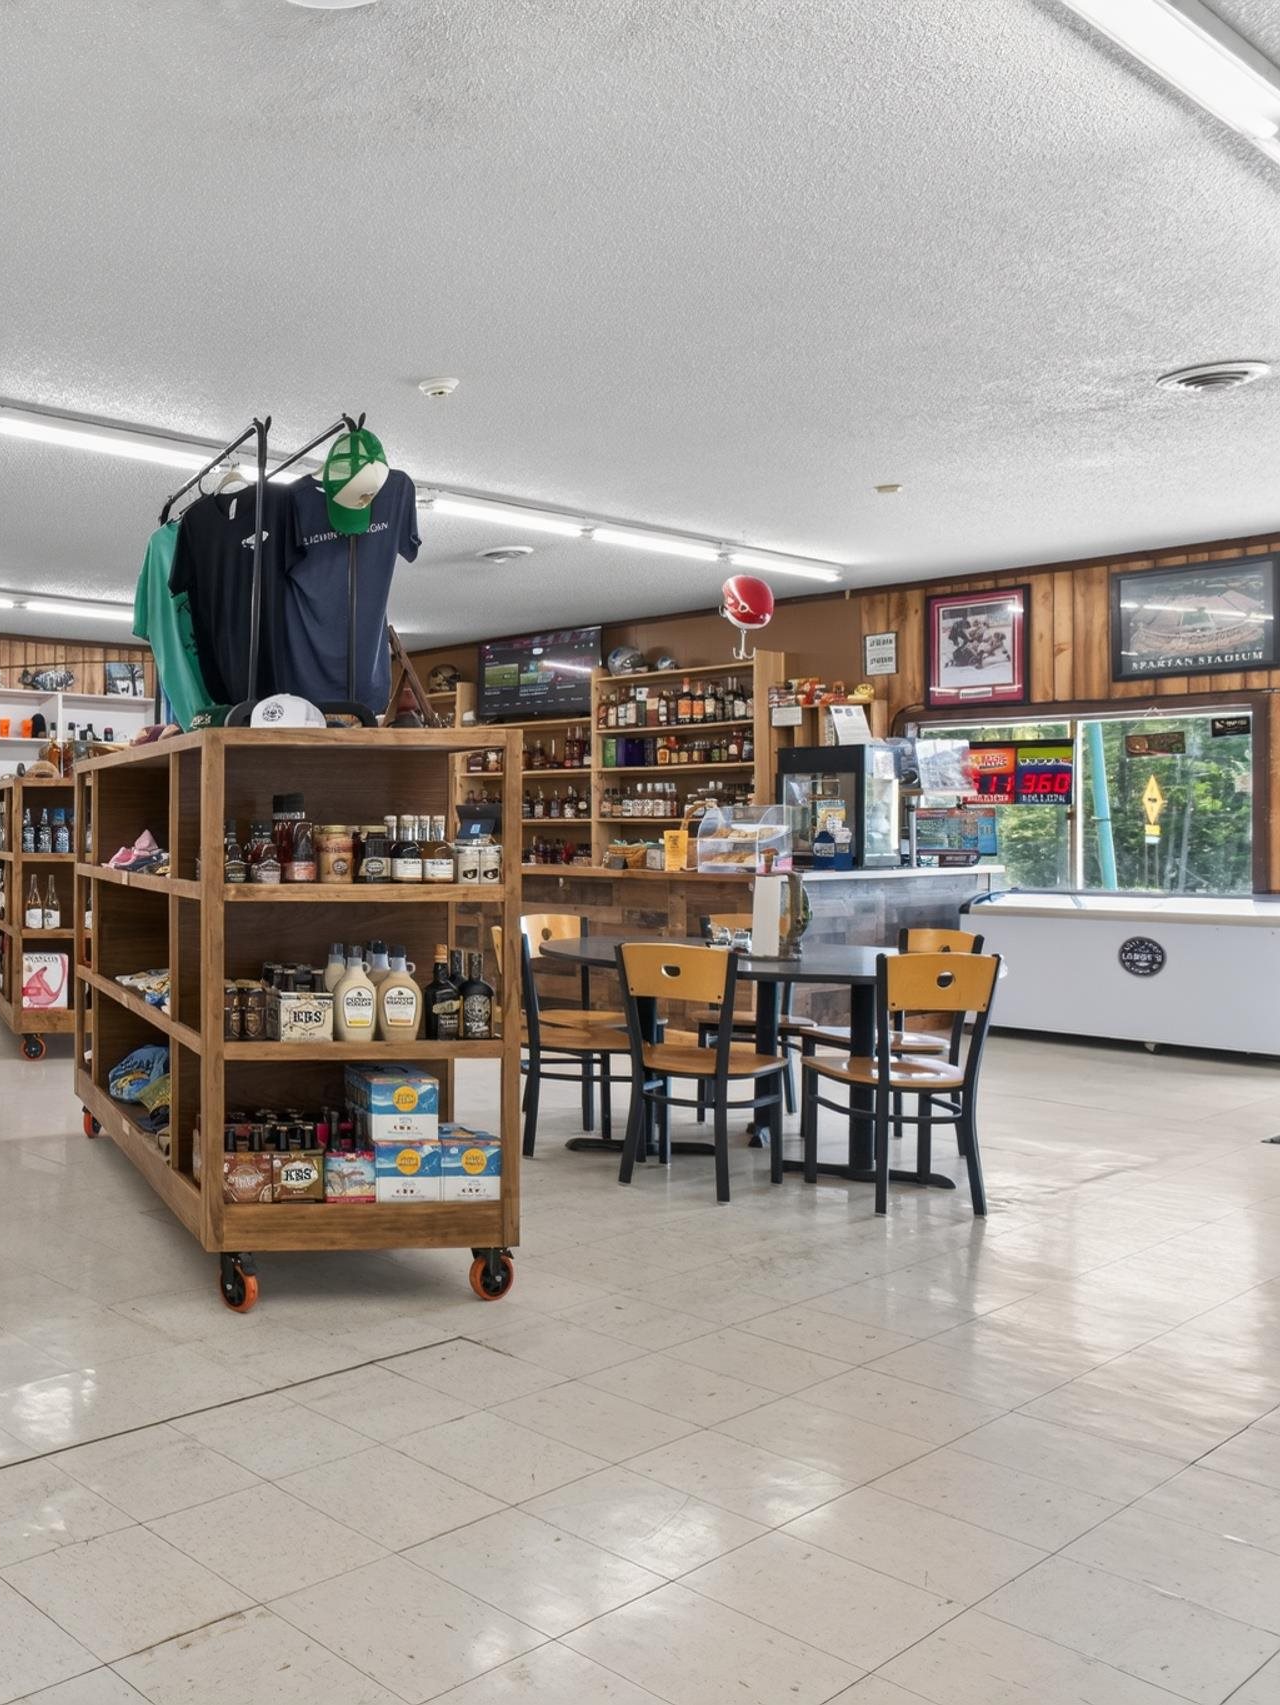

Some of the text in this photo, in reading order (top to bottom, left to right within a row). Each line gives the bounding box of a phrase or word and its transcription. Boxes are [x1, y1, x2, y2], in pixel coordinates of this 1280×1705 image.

[1131, 650, 1264, 672] SPARTAN STADIUM
[1020, 773, 1072, 795] 360
